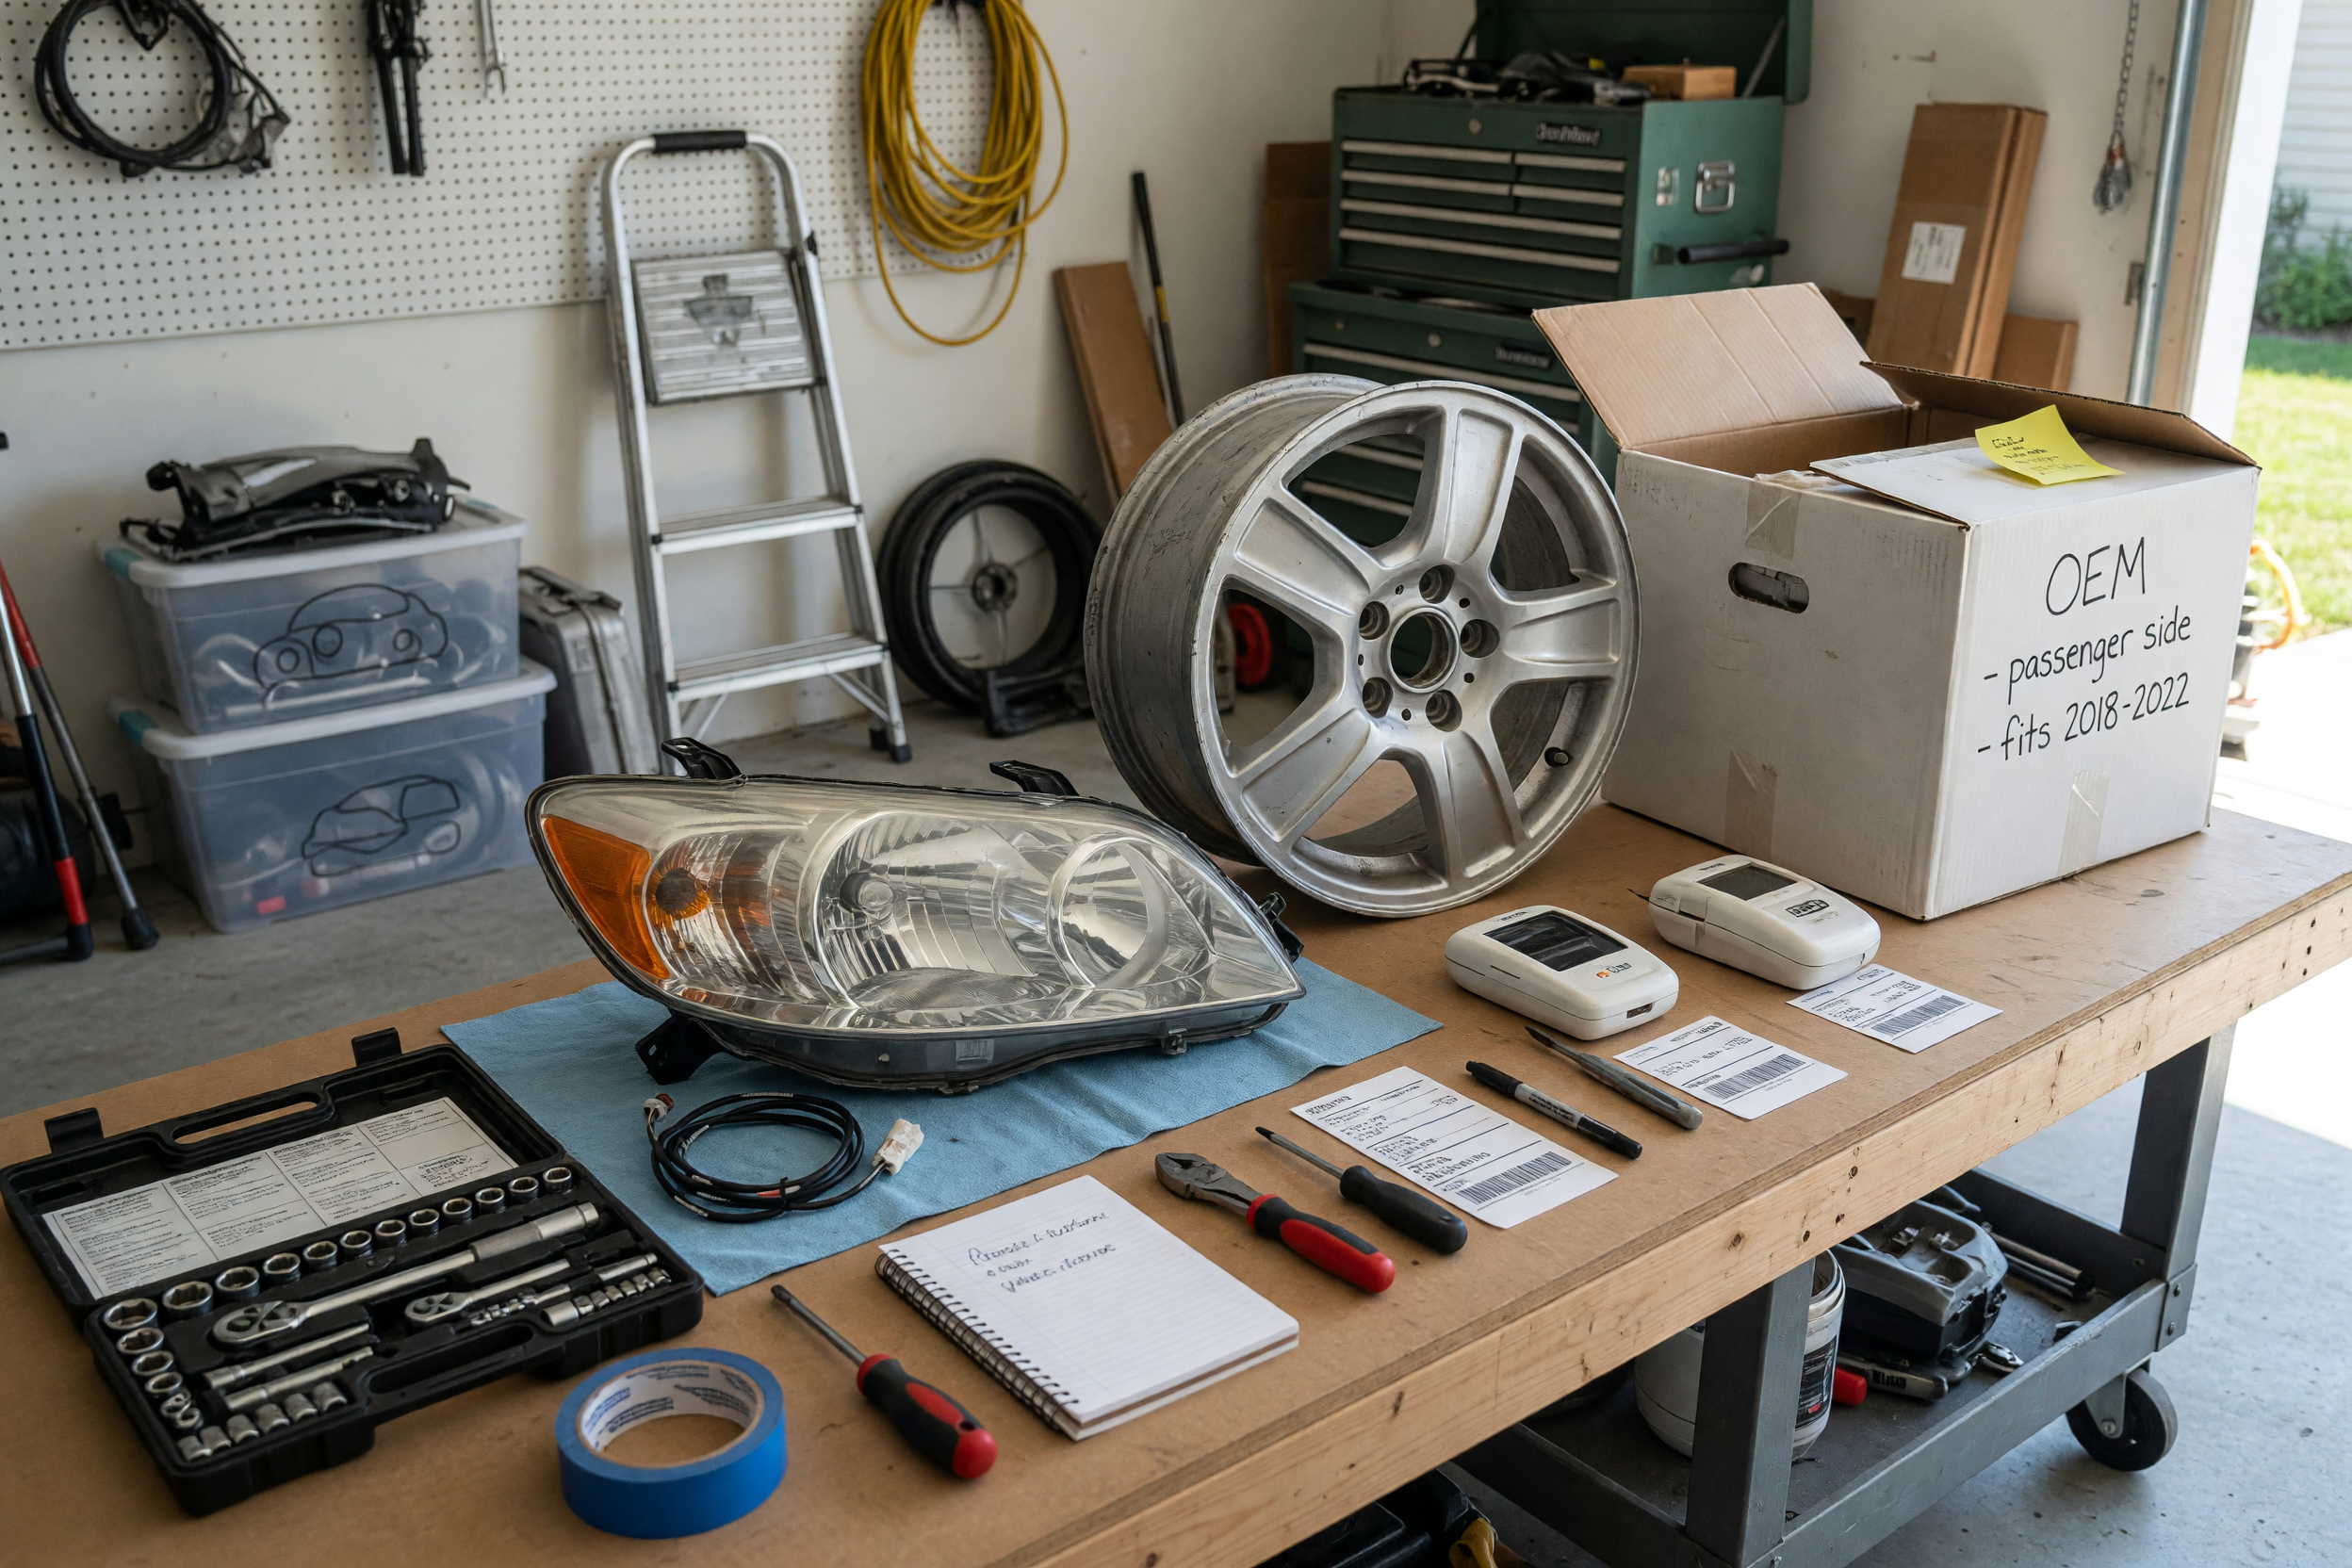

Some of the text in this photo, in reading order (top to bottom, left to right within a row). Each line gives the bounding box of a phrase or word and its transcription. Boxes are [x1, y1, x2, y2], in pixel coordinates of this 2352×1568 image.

[2046, 536, 2146, 615] OEM
[2007, 629, 2134, 706] passenger
[2143, 604, 2191, 650] side
[2001, 713, 2050, 761] fits
[2064, 672, 2190, 742] 2018-2022
